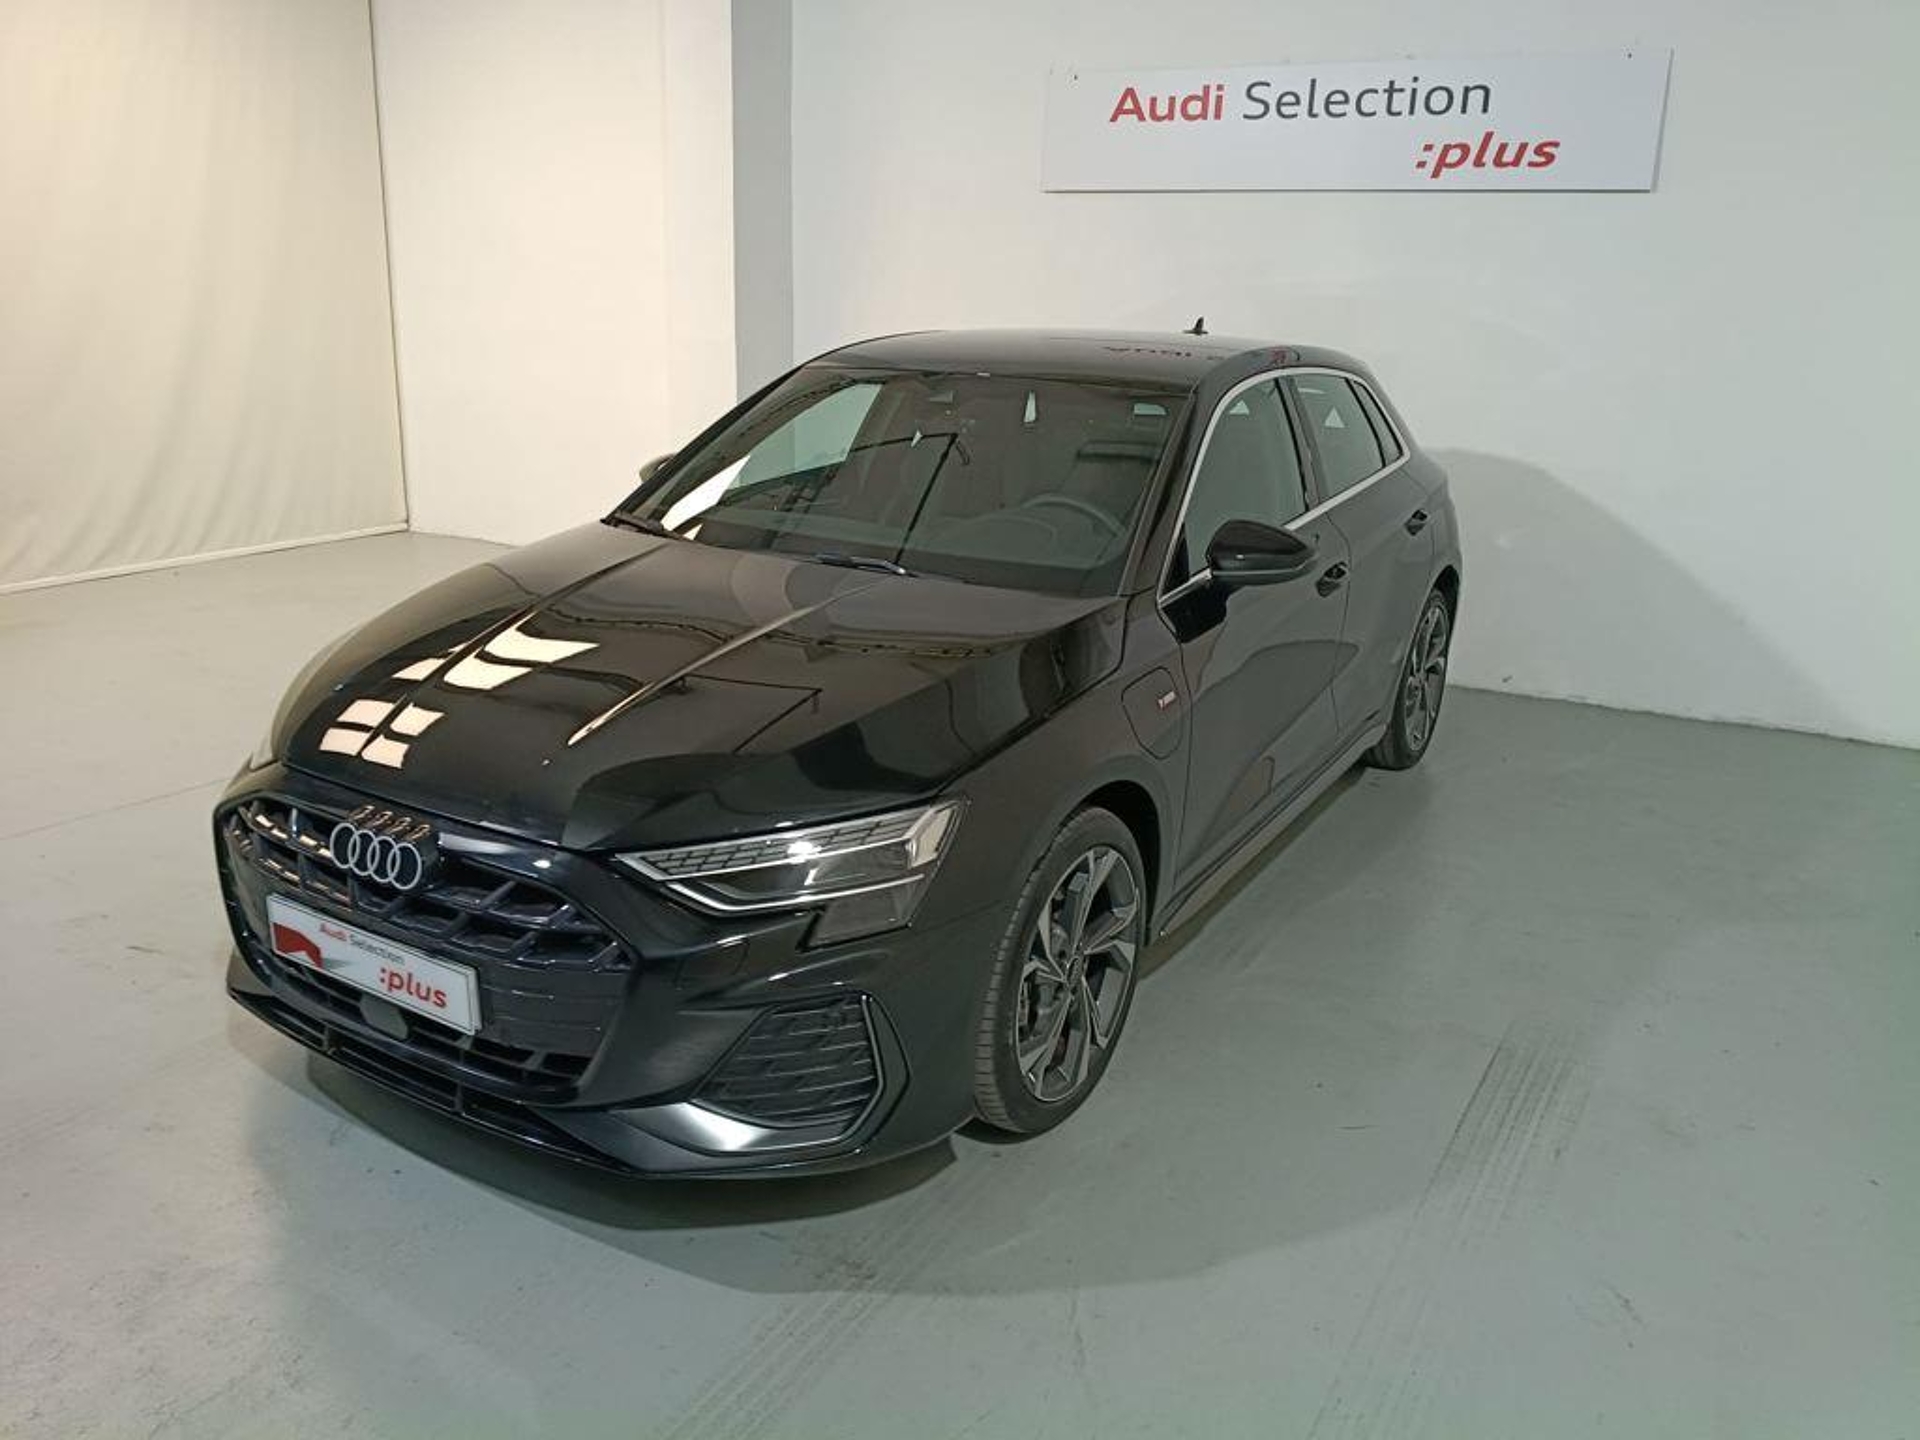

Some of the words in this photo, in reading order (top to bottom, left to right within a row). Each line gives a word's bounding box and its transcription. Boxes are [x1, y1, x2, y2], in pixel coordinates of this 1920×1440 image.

[1109, 84, 1225, 123] Audi
[1243, 76, 1492, 120] Selection
[1415, 131, 1561, 179] :plus
[379, 967, 448, 1009] :plus
